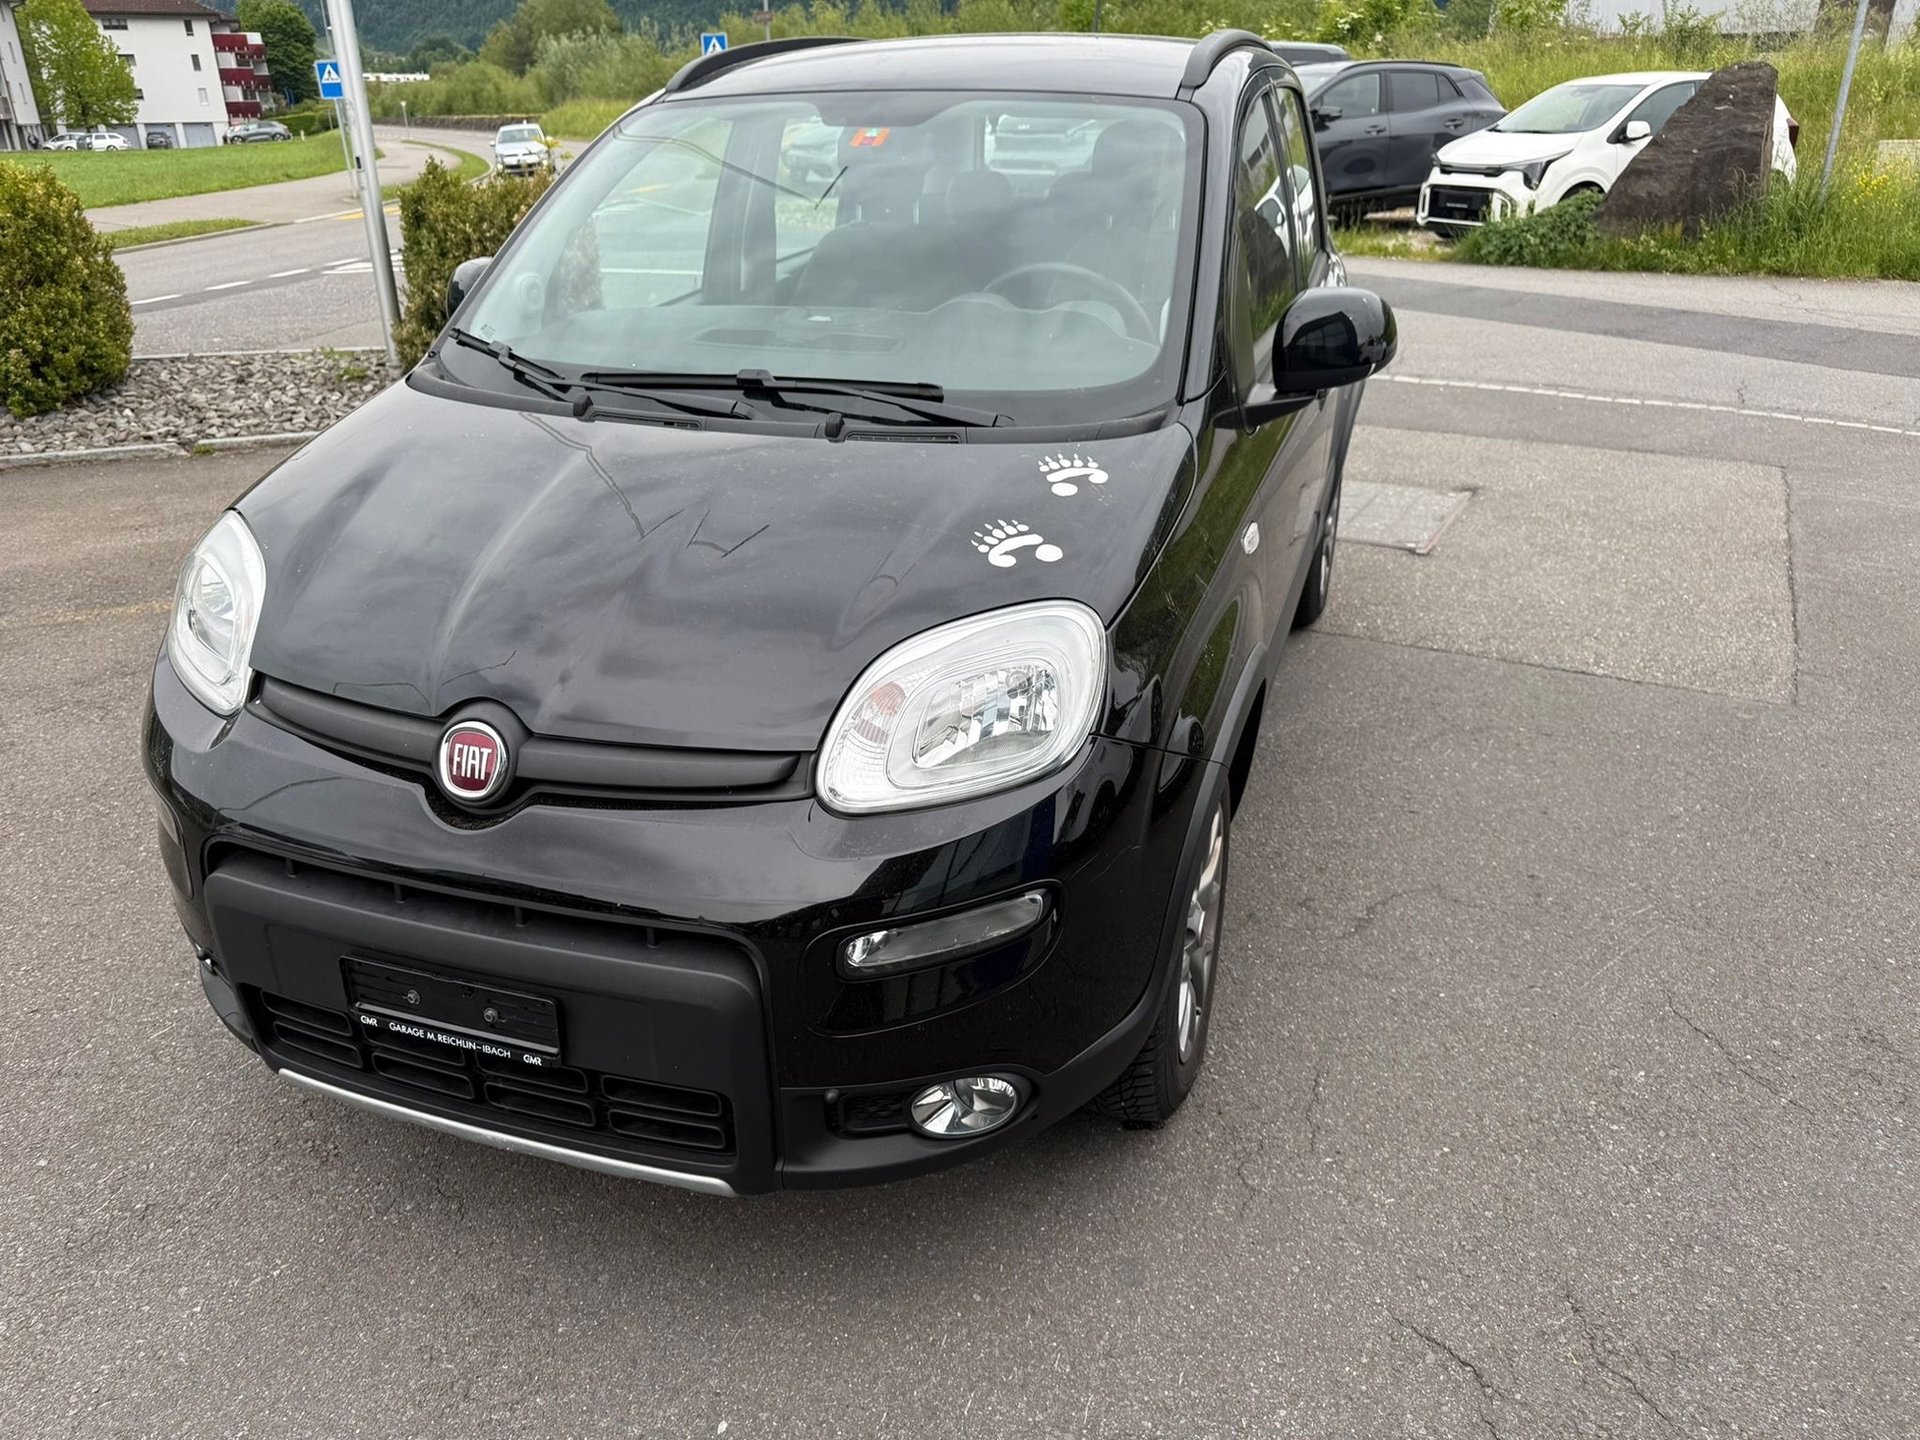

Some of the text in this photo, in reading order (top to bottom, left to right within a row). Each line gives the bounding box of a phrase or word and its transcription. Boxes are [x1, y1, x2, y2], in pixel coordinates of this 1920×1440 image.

[452, 743, 493, 781] FIAT
[388, 1022, 425, 1038] GARAGE
[426, 1031, 437, 1042] M.
